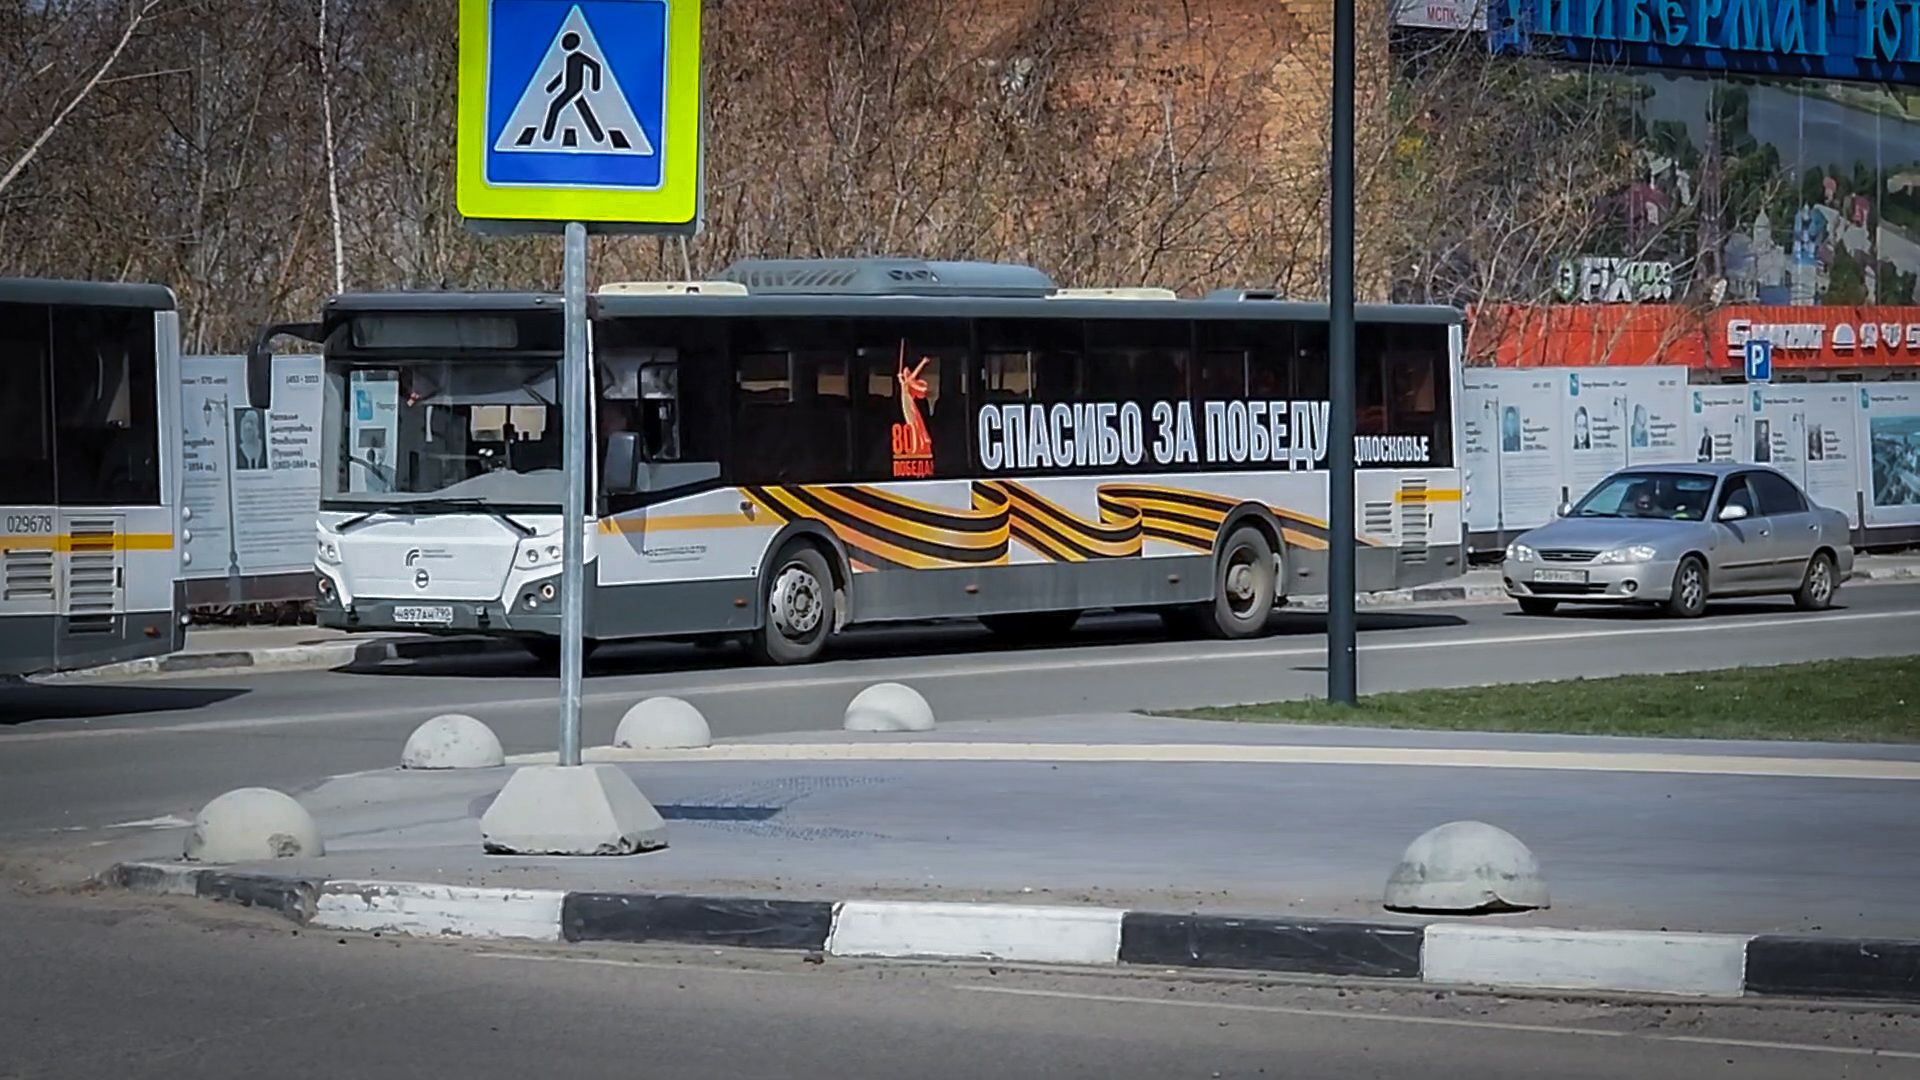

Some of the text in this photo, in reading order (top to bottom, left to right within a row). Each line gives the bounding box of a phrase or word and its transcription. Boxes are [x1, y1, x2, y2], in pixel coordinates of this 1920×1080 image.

[1857, 1, 1920, 62] Ю
[1751, 344, 1765, 377] P
[892, 423, 917, 454] 80
[978, 400, 1331, 472] СПАСИБО ЗА ПОБЕДУ
[1354, 435, 1430, 467] ДМОСКОВЬЕ
[7, 515, 52, 533] 029678
